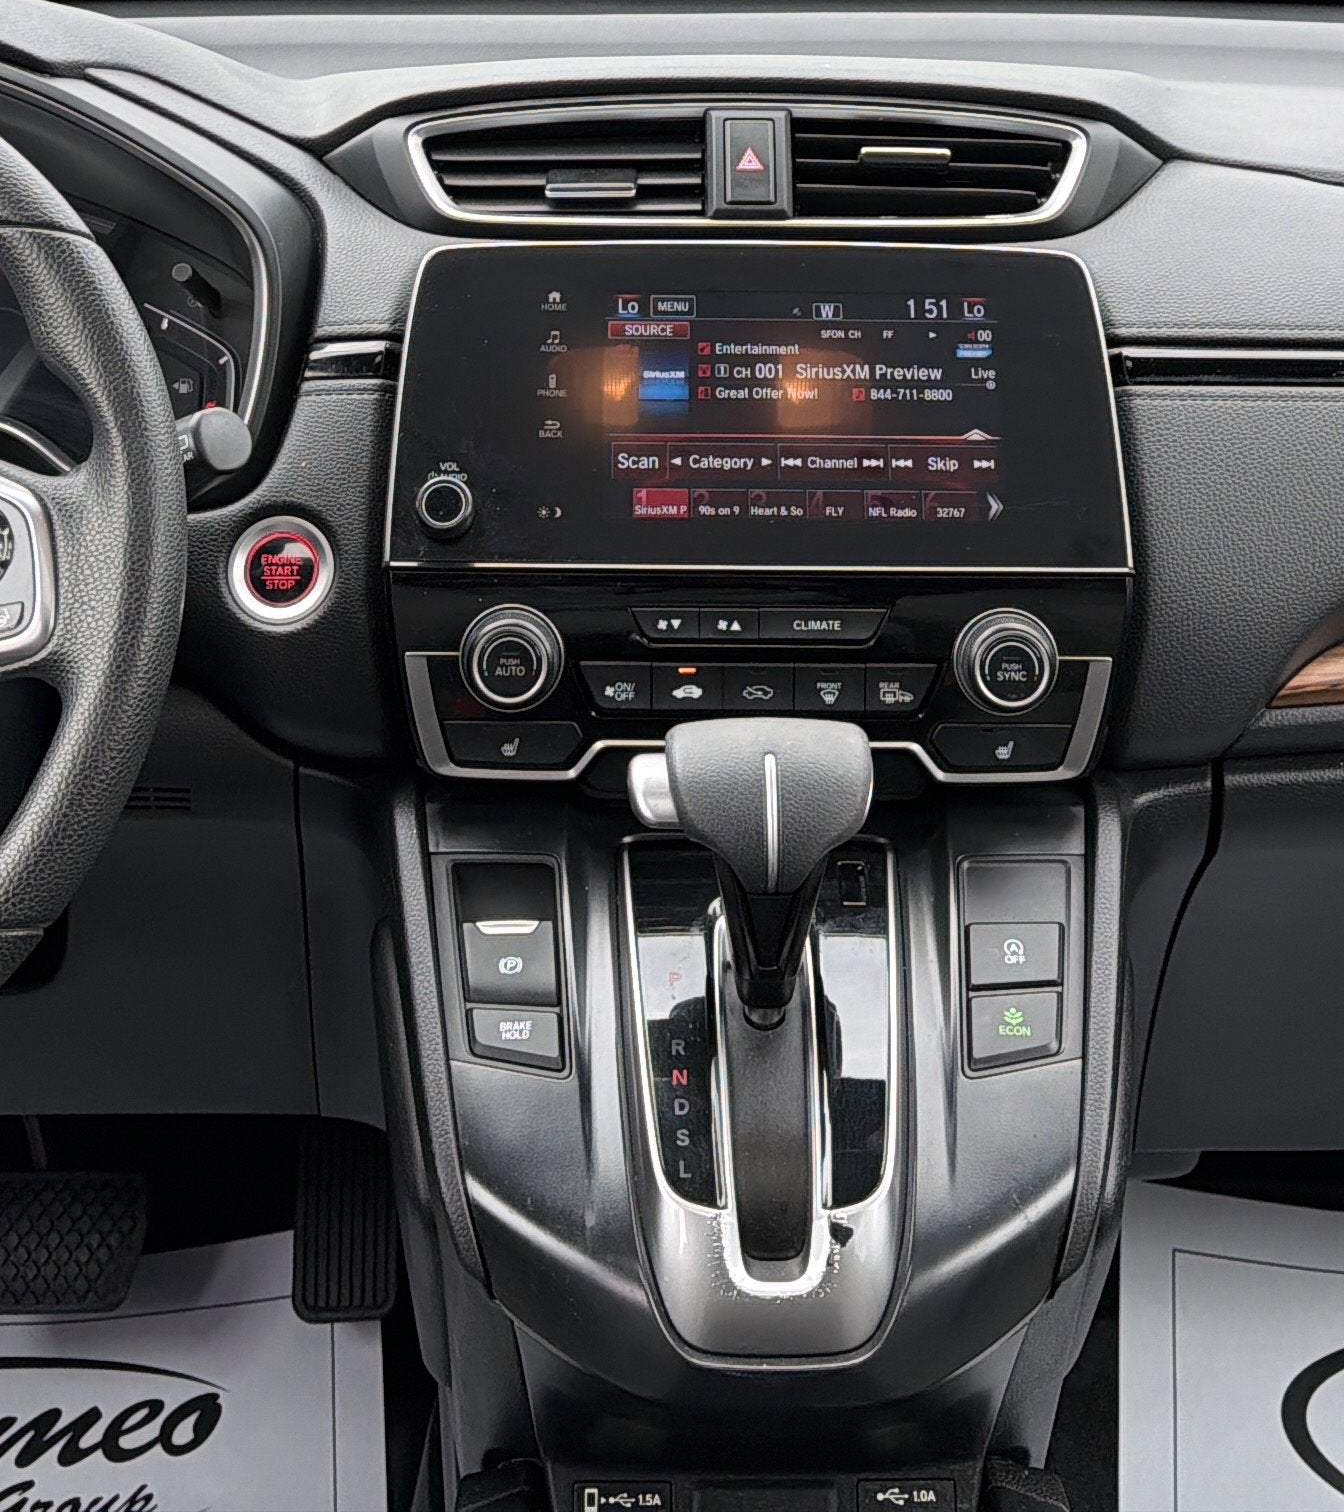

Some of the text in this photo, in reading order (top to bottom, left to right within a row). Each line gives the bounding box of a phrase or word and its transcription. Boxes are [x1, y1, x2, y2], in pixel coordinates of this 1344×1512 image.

[541, 303, 568, 311] HOME
[617, 297, 639, 315] Lo
[657, 301, 690, 312] MENU
[819, 304, 835, 319] W
[963, 301, 986, 318] Lo
[624, 324, 674, 336] SOURCE
[539, 344, 568, 353] AUDIO
[715, 342, 800, 356] Entertainment
[733, 368, 751, 378] CH
[755, 363, 784, 379] 001
[795, 363, 870, 380] SiriusXM
[875, 364, 943, 381] Preview
[971, 367, 996, 380] Live
[536, 389, 568, 398] PHONE
[715, 386, 953, 402] Great Offer Now! 844-711-8800
[538, 429, 563, 438] BACK
[439, 461, 460, 471] VOL
[617, 453, 959, 472] Scan Category Channel Skip
[634, 505, 687, 516] SiriusXM P
[699, 505, 740, 516] 90s on 9
[751, 505, 804, 516] Heart & So
[825, 506, 845, 517] FLY
[868, 506, 917, 517] NFL Radio
[936, 507, 965, 518] 32767
[260, 553, 304, 565] ENGINE
[263, 565, 299, 576] START
[265, 580, 296, 590] STOP
[793, 620, 842, 631] CLIMATE
[499, 657, 521, 666] PUSH
[1001, 662, 1023, 671] PUSH
[494, 666, 526, 676] AUTO
[996, 671, 1027, 682] SYNC
[614, 681, 636, 692] ON/
[816, 681, 843, 690] FRONT
[878, 681, 901, 689] REAR
[614, 691, 636, 701] OFF
[1003, 954, 1027, 965] OFF
[669, 972, 683, 985] P
[499, 1020, 533, 1032] BRAKE
[998, 1024, 1032, 1037] ECON
[501, 1029, 531, 1041] HOLD
[671, 1039, 686, 1056] R
[671, 1068, 688, 1086] N
[673, 1098, 690, 1116] D
[676, 1128, 690, 1146] S
[679, 1160, 692, 1178] L
[638, 1494, 662, 1507] 1.5A
[913, 1491, 937, 1504] 1.0A
